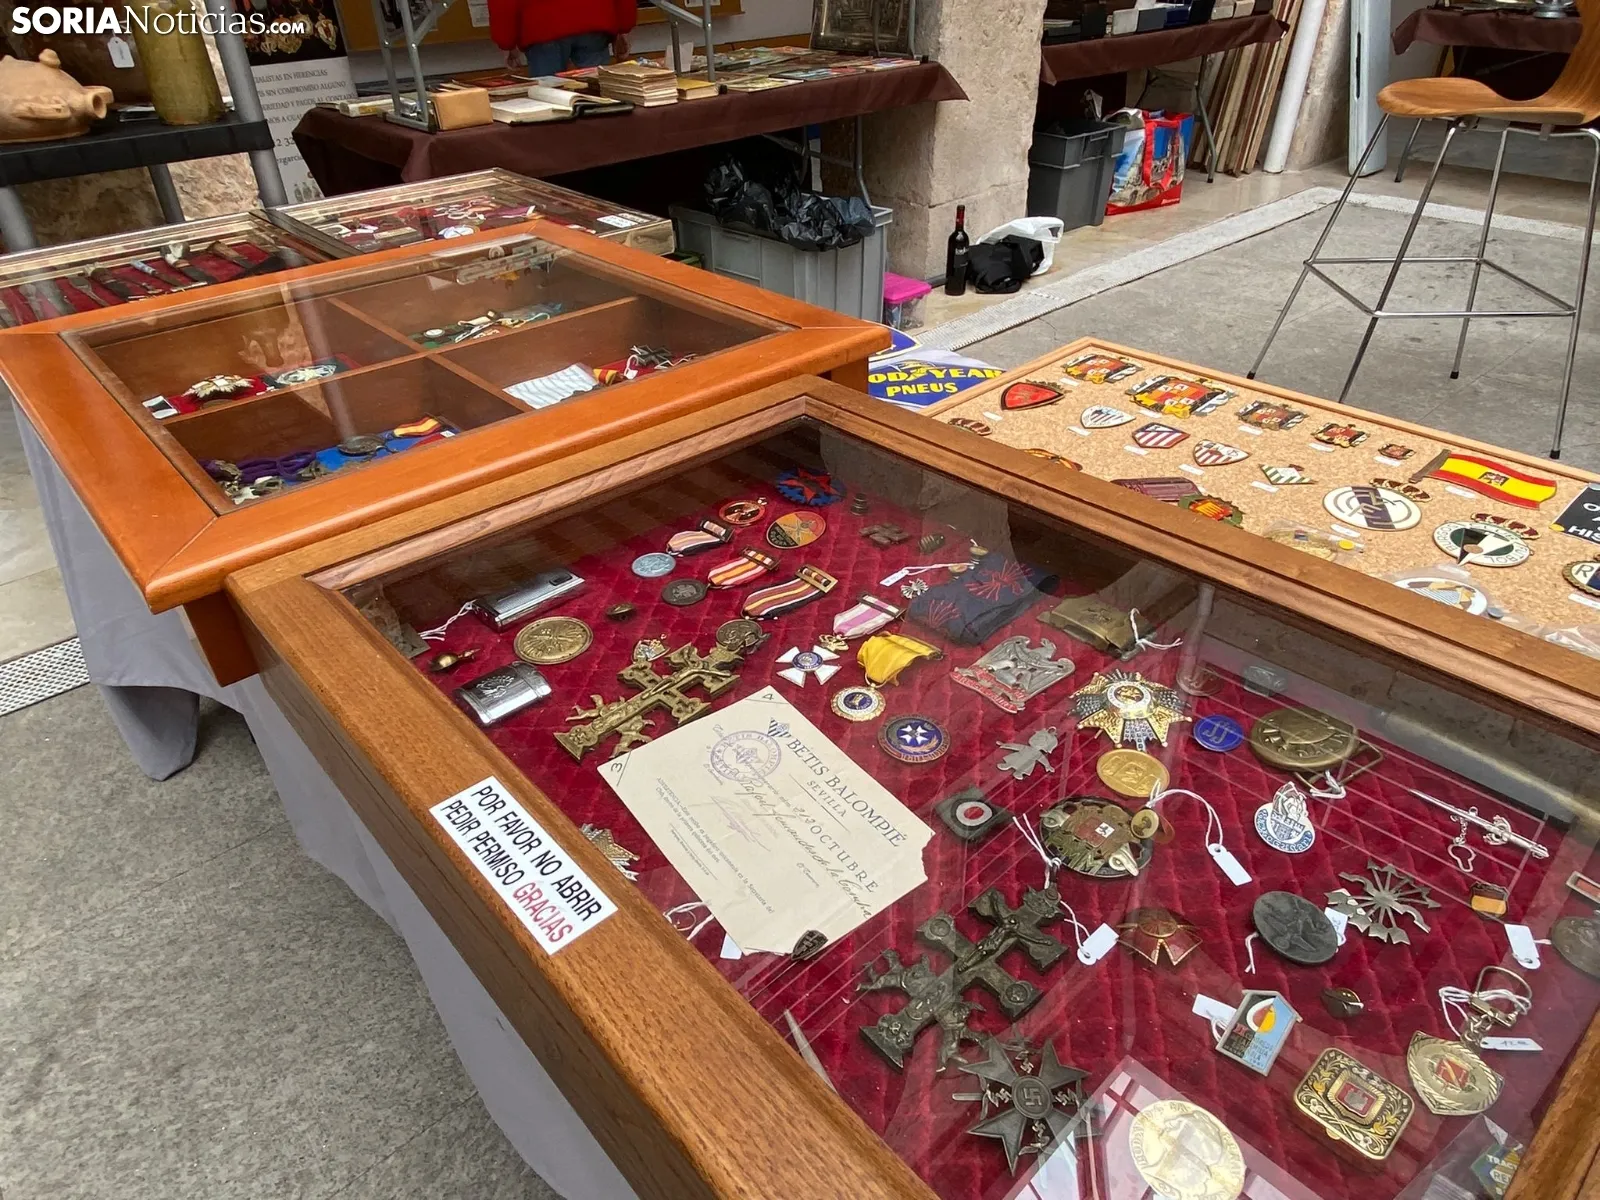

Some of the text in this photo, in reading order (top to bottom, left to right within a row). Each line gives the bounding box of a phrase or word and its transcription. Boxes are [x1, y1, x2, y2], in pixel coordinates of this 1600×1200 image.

[886, 382, 958, 397] PNEUS
[806, 779, 848, 818] SEVILLA
[440, 800, 573, 943] PEDIR PERMISO GRACIAS
[470, 785, 602, 922] POR FAVOR NO ABRIR
[809, 823, 879, 894] OCTUBRE
